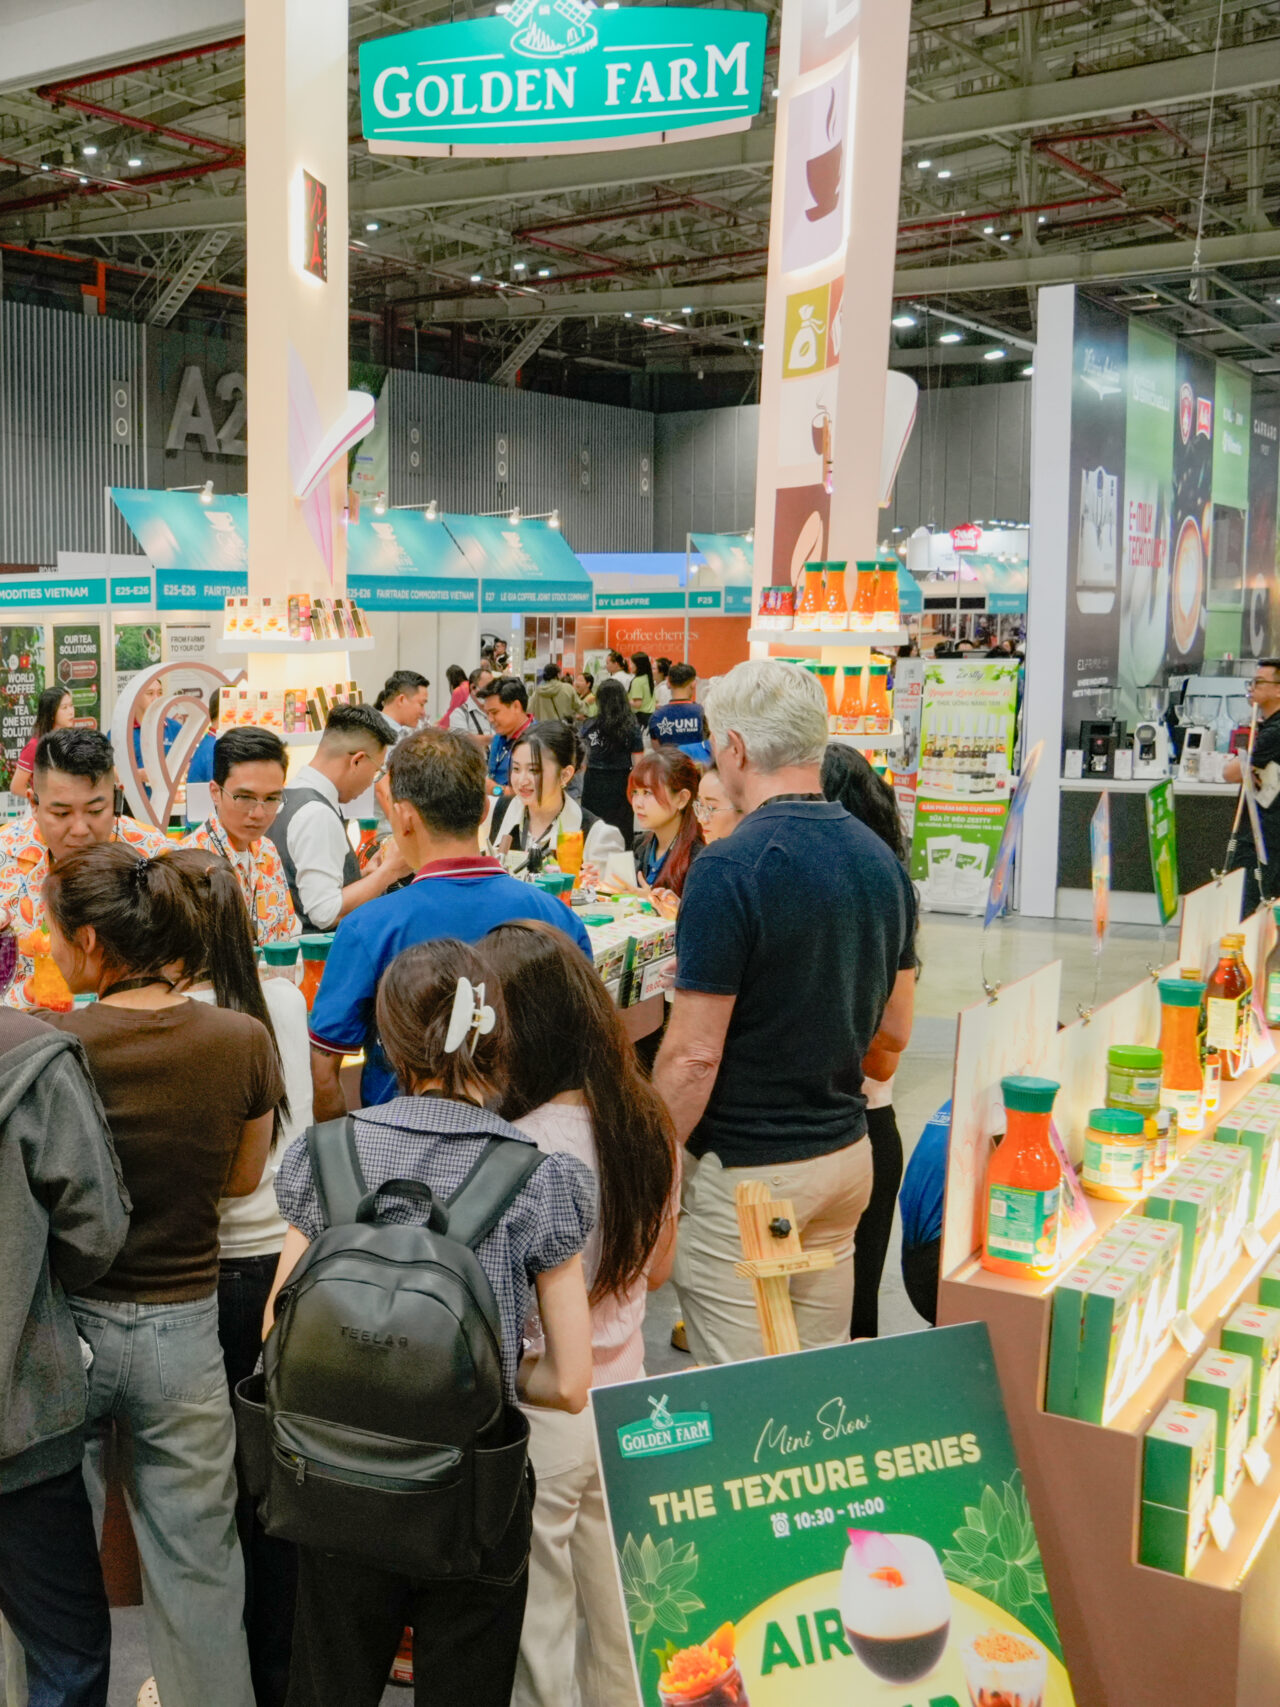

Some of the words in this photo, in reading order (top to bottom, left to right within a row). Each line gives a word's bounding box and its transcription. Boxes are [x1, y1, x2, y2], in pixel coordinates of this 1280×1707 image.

[373, 66, 577, 118] GOLDEN
[605, 41, 751, 106] FARM
[44, 587, 88, 599] VIETNAM
[115, 586, 149, 595] E25-E26
[163, 584, 197, 596] E25-E26
[203, 585, 247, 596] FAIRTRADE
[376, 588, 410, 598] FAIRTRADE
[410, 589, 449, 599] COMMODITIES
[450, 590, 474, 600] VIETNAM
[610, 597, 650, 606] LESAFFRE
[64, 635, 79, 644] OUR
[80, 635, 92, 643] TEA
[616, 627, 653, 641] Coffee
[59, 644, 97, 655] SOLUTIONS
[8, 673, 35, 683] WORLD
[6, 685, 35, 694] COFFEE
[14, 706, 29, 715] TEA
[3, 717, 19, 727] ONE
[20, 716, 37, 726] STO
[675, 718, 698, 728] UNI
[17, 738, 25, 747] IN
[5, 749, 21, 759] VIET
[753, 1418, 814, 1464] Mini
[816, 1396, 873, 1441] Show
[622, 1431, 671, 1452] GOLDEN
[676, 1420, 710, 1441] FARM
[649, 1485, 717, 1526] THE
[723, 1455, 869, 1511] TEXTURE
[874, 1433, 982, 1481] SERIES
[793, 1506, 836, 1530] 10:30
[847, 1496, 886, 1521] 11:00
